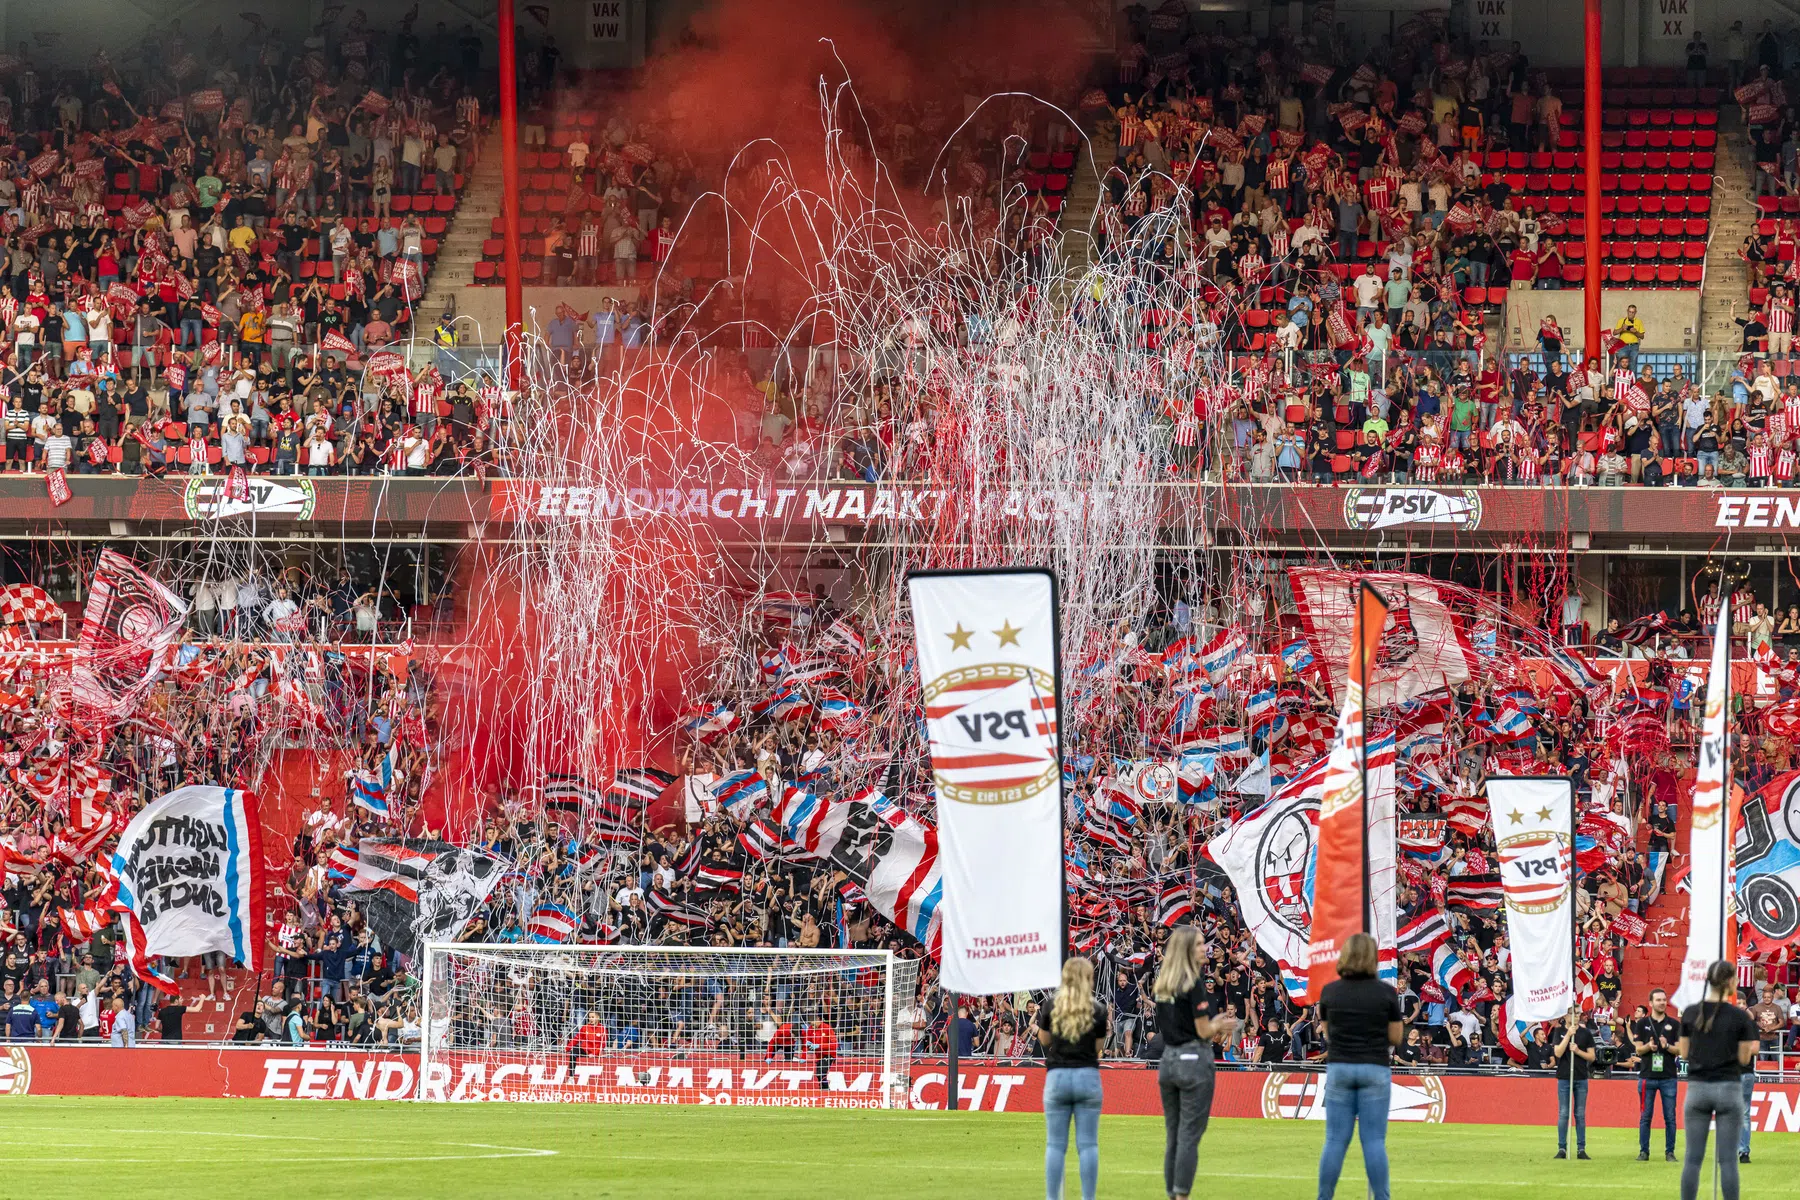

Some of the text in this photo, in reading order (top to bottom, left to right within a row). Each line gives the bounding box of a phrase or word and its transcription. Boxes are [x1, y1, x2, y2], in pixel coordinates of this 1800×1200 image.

[592, 3, 620, 17] VAK
[1476, 1, 1505, 15] VAK
[1660, 0, 1688, 14] VAK
[592, 24, 619, 38] WW
[1480, 21, 1500, 37] XX
[1662, 20, 1683, 36] XX
[537, 486, 797, 519] EENDRACHT
[1387, 494, 1438, 514] PSV
[259, 1058, 604, 1101] EENDRACHT
[509, 1090, 679, 1105] BRAINPORT EINDHOVEN
[736, 1094, 907, 1110] BRAINPORT EINDHOVN
